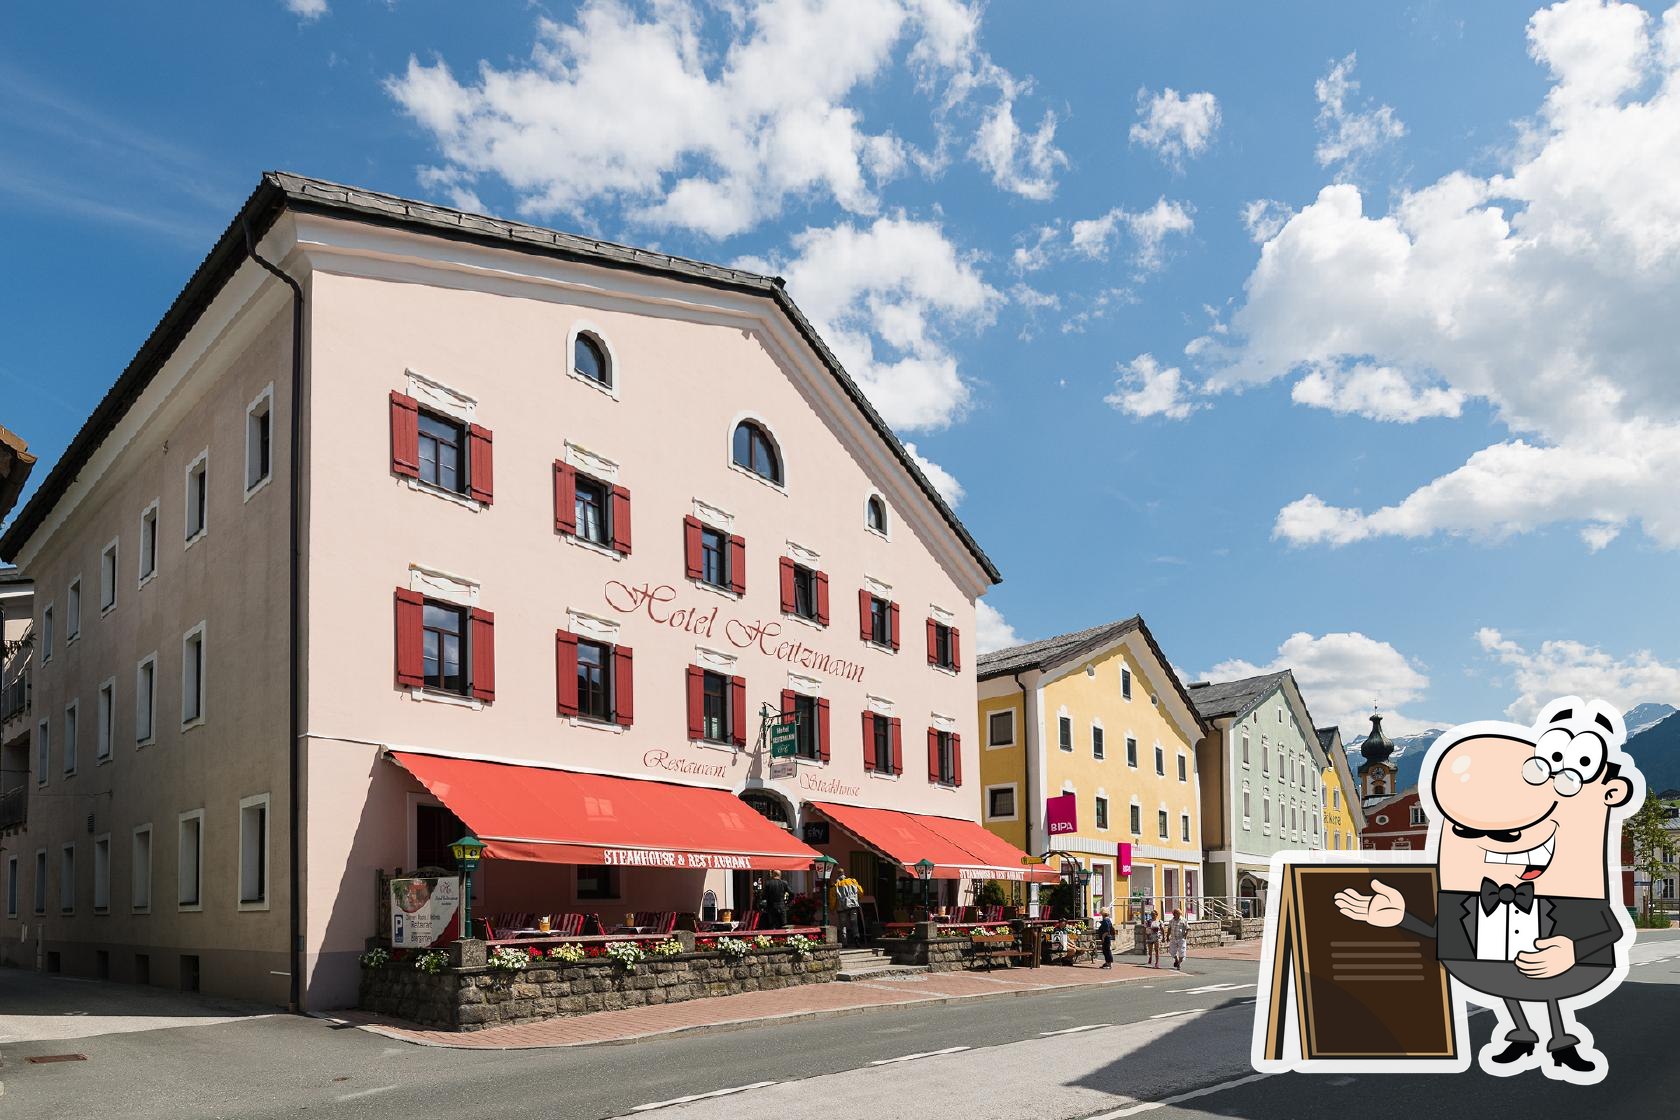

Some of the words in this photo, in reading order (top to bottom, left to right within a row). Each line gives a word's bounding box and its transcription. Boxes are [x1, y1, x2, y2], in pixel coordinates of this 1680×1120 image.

[604, 580, 718, 638] Hotel
[725, 619, 865, 683] Heitzmann
[643, 749, 727, 778] Restaurant
[1051, 822, 1074, 832] BIPA
[603, 849, 676, 867] STEAKHOUSE
[677, 854, 686, 866] &
[687, 854, 752, 869] RESTAURANT
[395, 916, 402, 934] P
